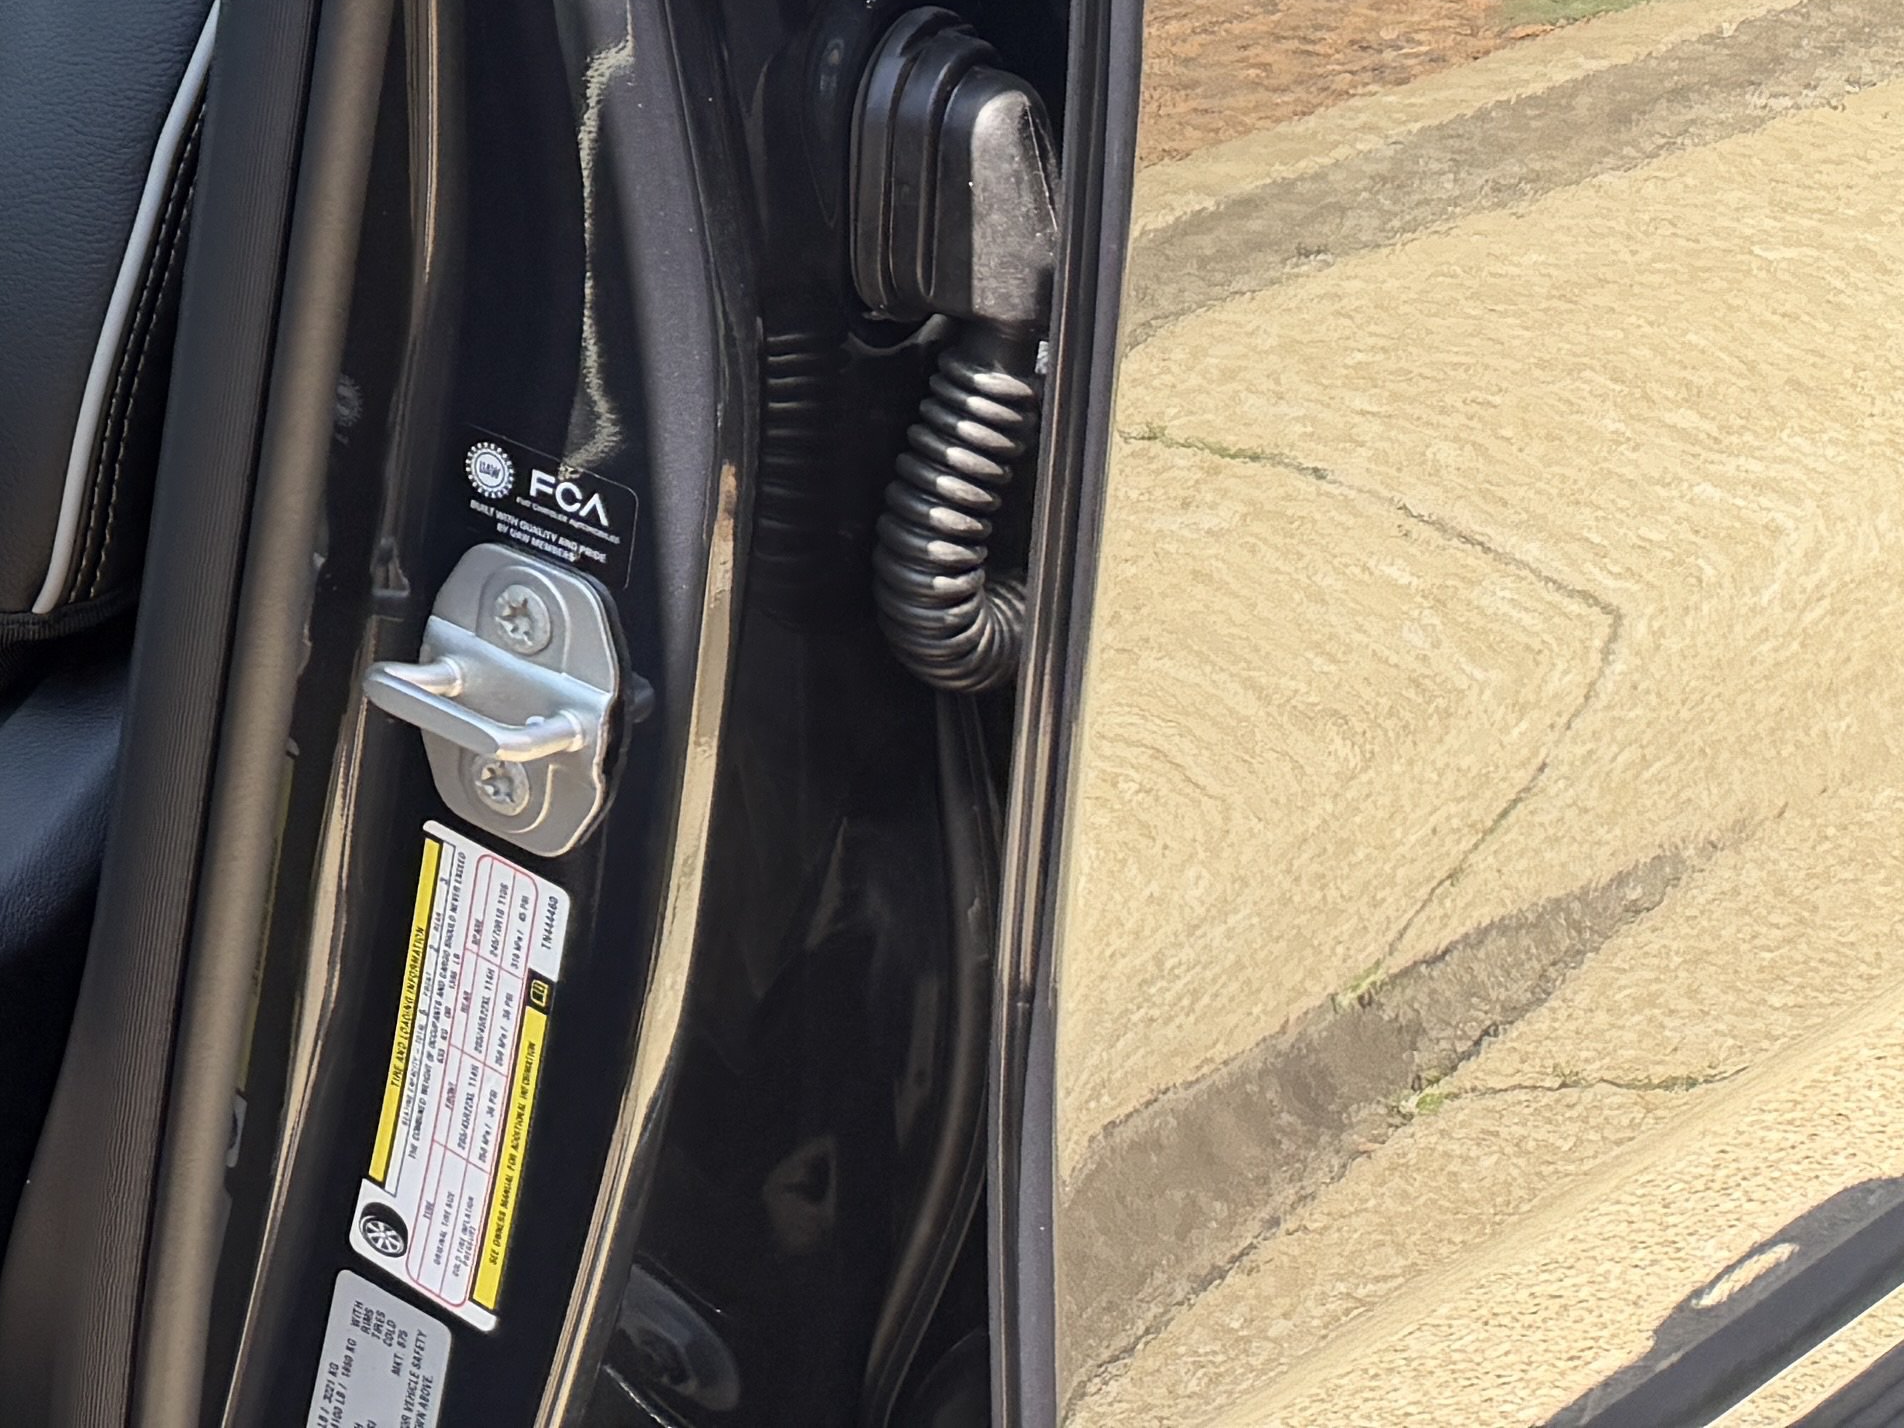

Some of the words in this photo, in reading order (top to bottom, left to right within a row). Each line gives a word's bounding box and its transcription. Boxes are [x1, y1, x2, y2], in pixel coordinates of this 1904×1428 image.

[529, 468, 611, 527] FCA
[470, 498, 494, 517] BUILT
[495, 509, 518, 526] WITH
[519, 519, 557, 543] QUALITY
[558, 535, 577, 551] AND
[578, 543, 607, 564] PRIDE
[496, 522, 508, 534] BY
[509, 527, 530, 544] UAW
[531, 536, 576, 563] MEMBERS
[453, 850, 466, 885] EXCEED
[449, 884, 461, 914] NEVER
[443, 913, 456, 949] SHOULD
[405, 924, 425, 994] INFORMATION
[438, 948, 450, 979] CARGO
[452, 951, 460, 965] LB
[435, 979, 445, 998] AND
[398, 995, 415, 1040] LOADING
[427, 998, 443, 1050] OCCUPANTS
[395, 1039, 408, 1064] AND
[425, 1050, 434, 1063] OF
[390, 1063, 403, 1089] TIRE
[419, 1062, 432, 1096] WEIGHT
[423, 1199, 433, 1220] TIRE
[444, 1080, 456, 1109] FRONT
[460, 989, 471, 1014] REAR
[470, 917, 482, 946] SPARE
[518, 1039, 536, 1100] INFORMATION
[411, 1096, 426, 1142] COMBINED
[510, 1101, 526, 1152] ADDITIONAL
[408, 1142, 418, 1160] THE
[506, 1151, 517, 1171] FOR
[444, 1190, 455, 1209] SIZE
[499, 1172, 513, 1209] MANUAL
[440, 1208, 451, 1227] TIRE
[460, 1193, 475, 1237] INFLATION
[432, 1228, 447, 1266] ORIGINAL
[456, 1235, 466, 1255] TIRE
[488, 1247, 499, 1266] SEE
[350, 1299, 363, 1329] WITH
[361, 1306, 374, 1335] RIMS
[370, 1308, 385, 1341] TIRES
[345, 1336, 357, 1353] KG
[382, 1317, 397, 1348] COLD
[410, 1327, 427, 1371] SAFETY
[327, 1360, 339, 1377] KG
[334, 1389, 346, 1405] LB
[402, 1369, 420, 1413] VEHICLE
